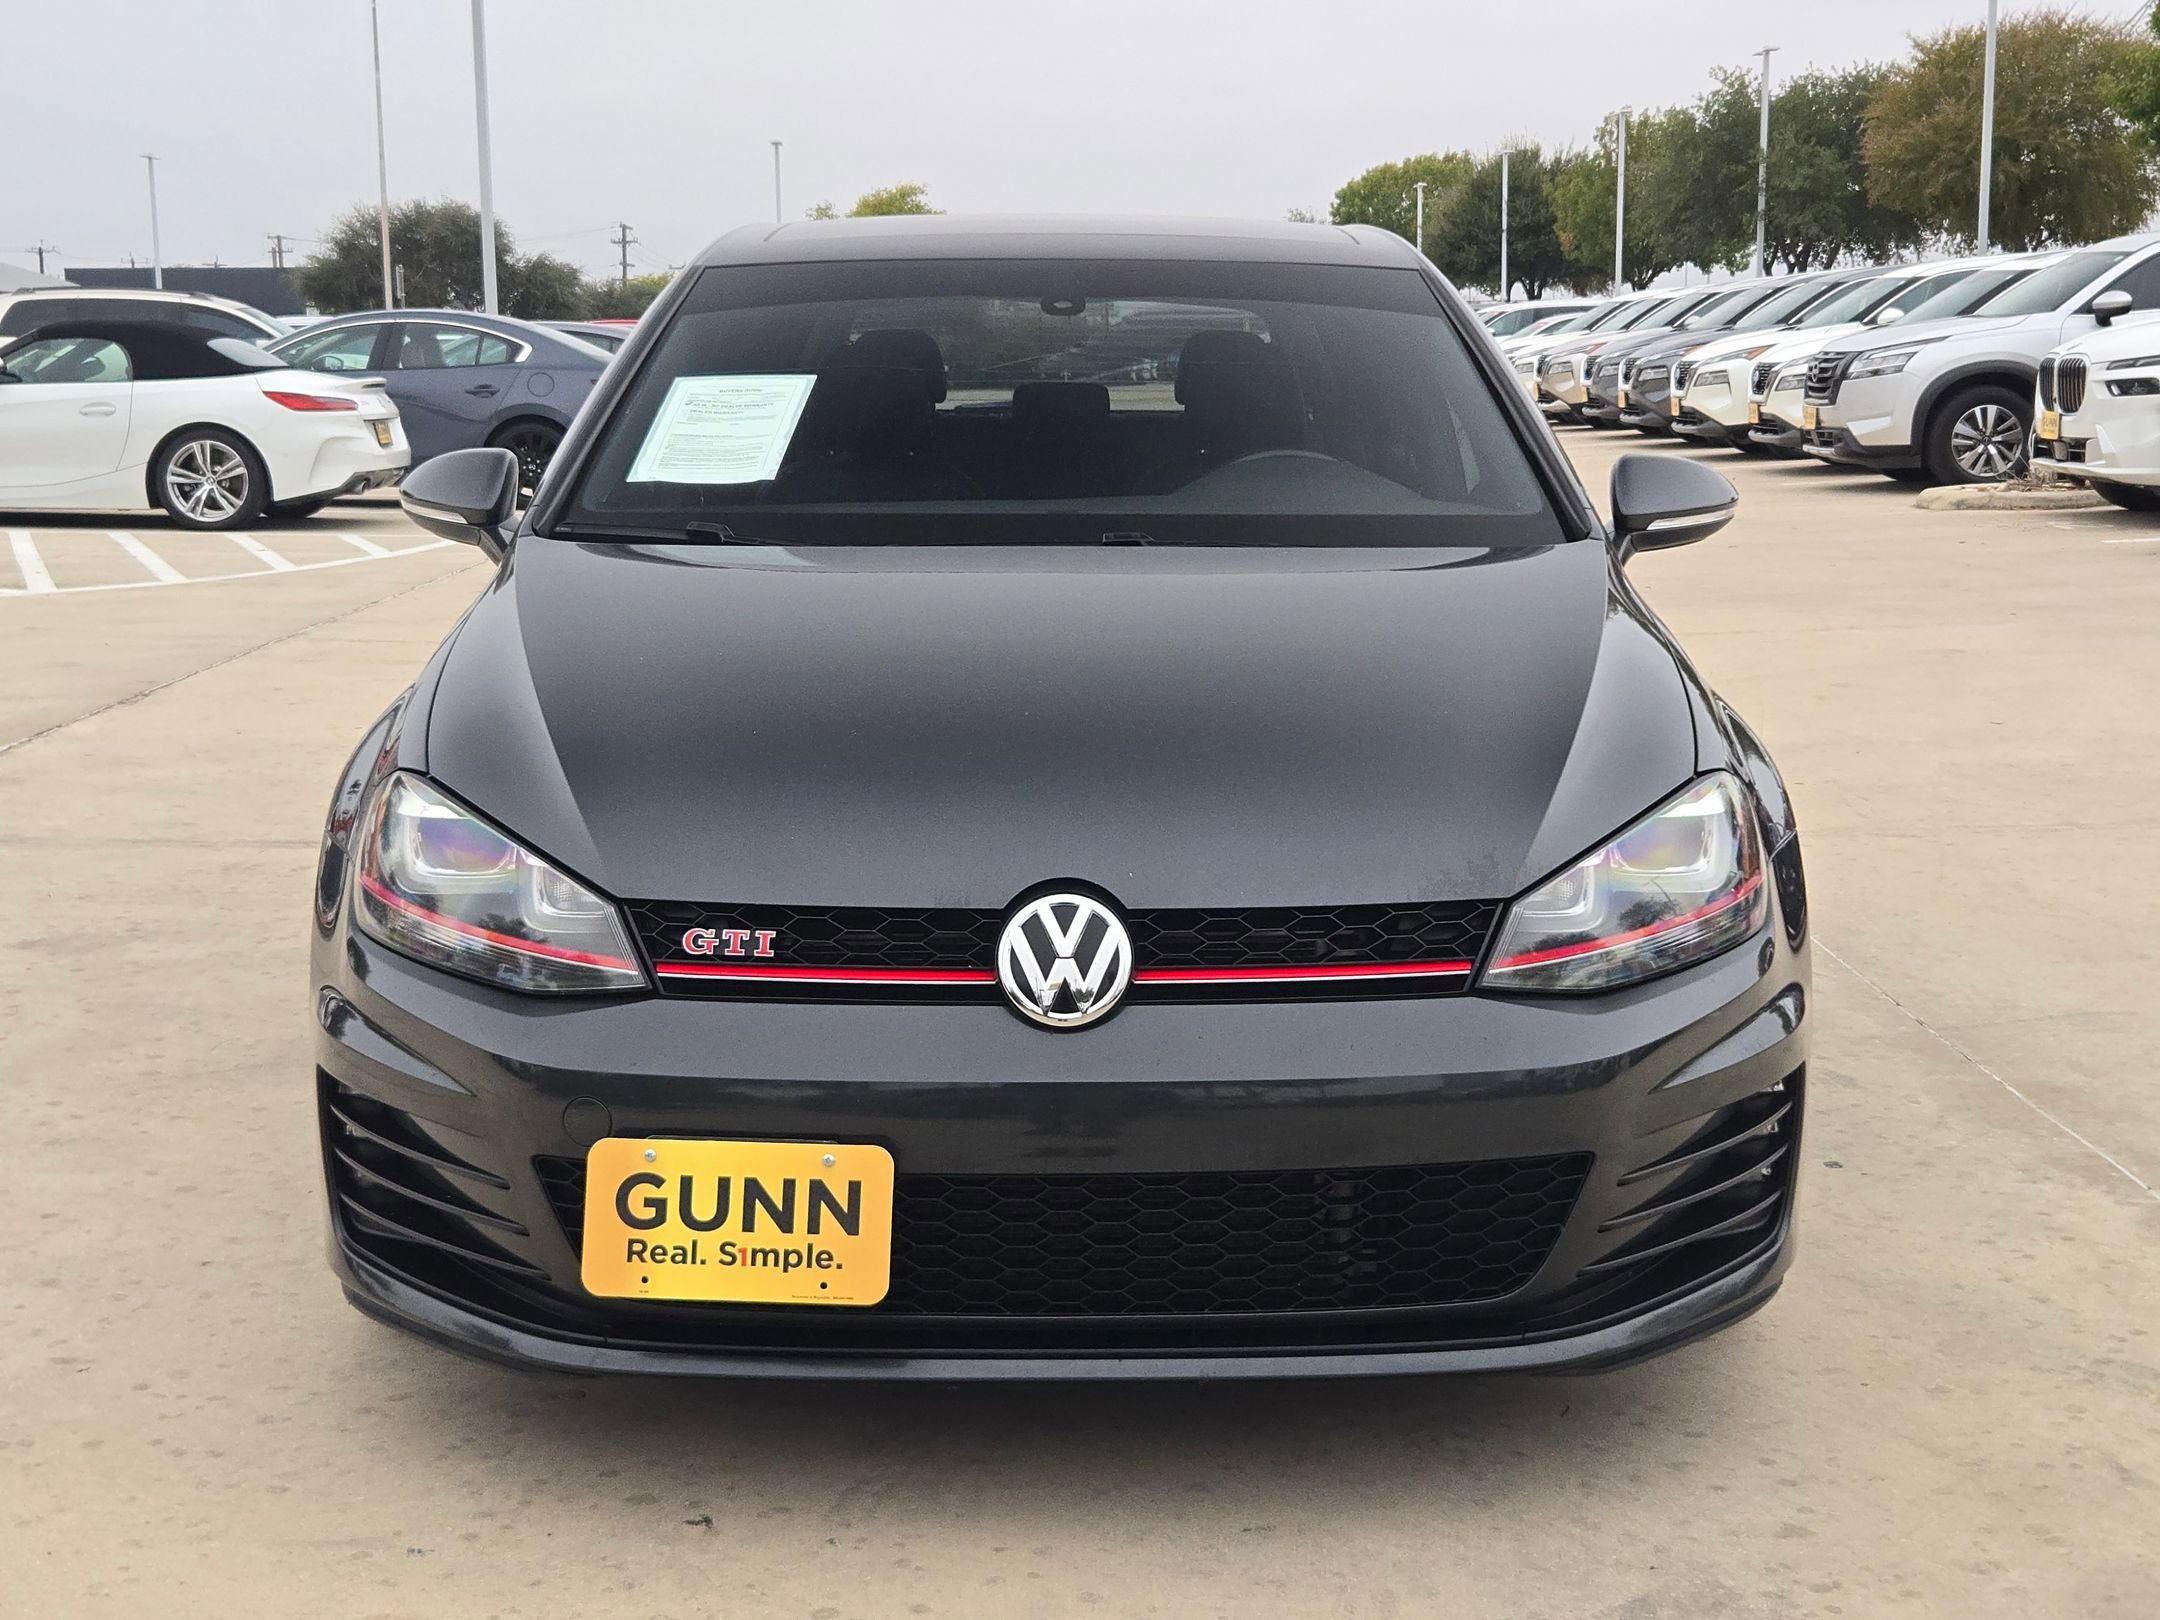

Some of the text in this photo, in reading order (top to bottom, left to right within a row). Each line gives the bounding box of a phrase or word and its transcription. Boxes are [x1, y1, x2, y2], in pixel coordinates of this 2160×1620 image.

[682, 927, 776, 957] GTI
[615, 1172, 862, 1236] GUNN
[626, 1238, 843, 1273] Real. S1mple.
